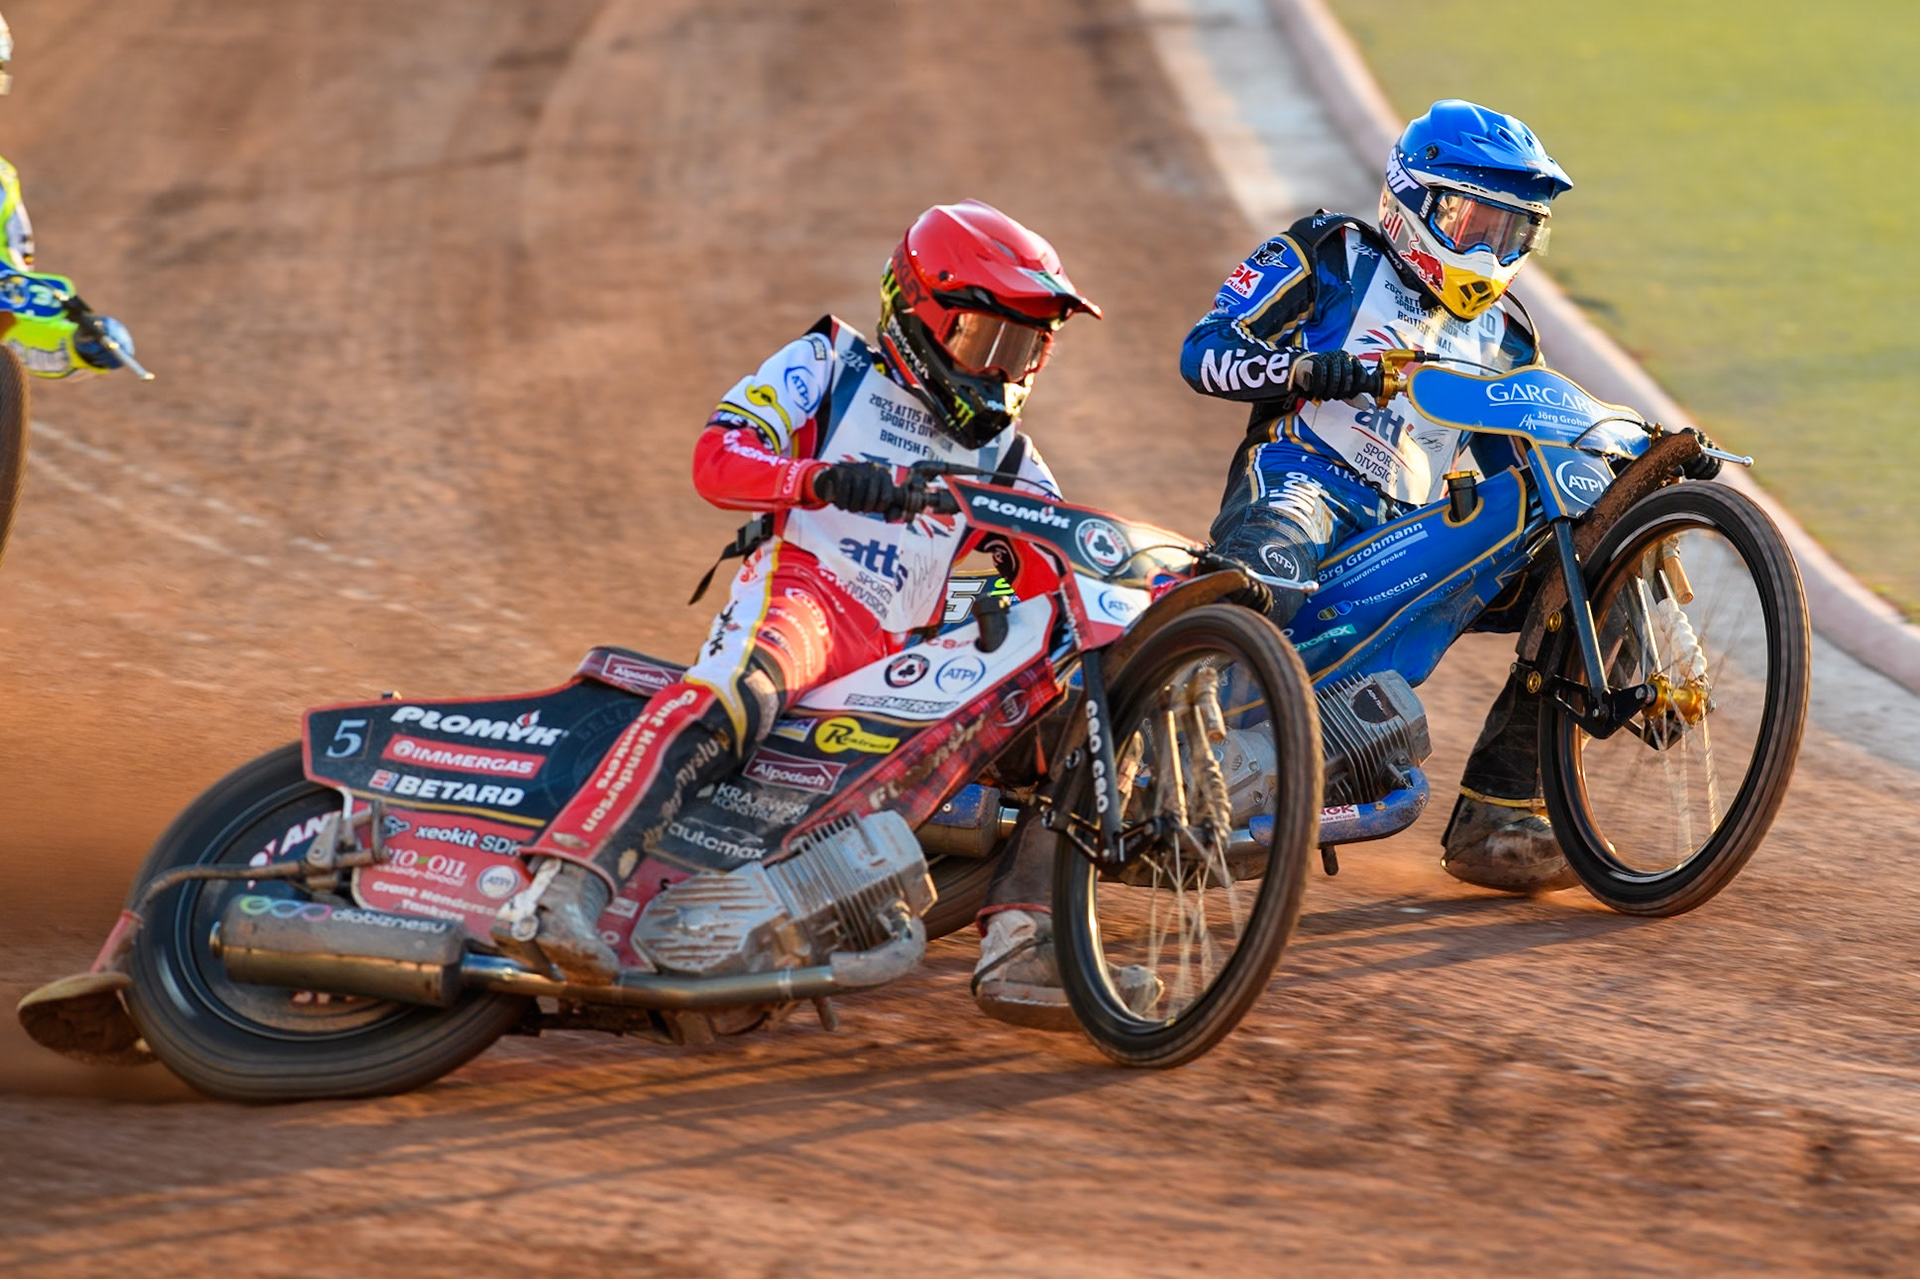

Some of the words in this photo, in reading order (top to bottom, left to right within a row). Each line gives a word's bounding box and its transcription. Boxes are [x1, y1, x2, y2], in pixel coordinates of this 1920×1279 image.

[1382, 212, 1404, 243] ull
[1230, 262, 1258, 289] GK
[868, 393, 894, 412] 2025
[894, 404, 922, 423] ATTIS
[880, 410, 916, 433] SPORTS
[1537, 410, 1559, 423] Jörg
[879, 429, 921, 457] BRITISH
[1362, 441, 1401, 475] SPORTS
[1569, 474, 1604, 493] ATPI
[1268, 551, 1295, 575] ATPI
[1316, 563, 1344, 584] örg
[1346, 522, 1424, 567] Grohmann
[1342, 563, 1381, 588] Insurance
[1380, 549, 1408, 567] Broker
[1354, 571, 1429, 606] Teletecnica
[1292, 625, 1352, 652] OTOREX
[613, 665, 669, 686] Alpodach
[942, 667, 978, 683] ATPI
[649, 689, 699, 728] Grant
[325, 718, 369, 760] 5
[412, 747, 535, 775] IMMERGAS
[752, 763, 826, 787] Alpodach
[394, 774, 525, 807] BETARD
[581, 729, 657, 833] Henderson
[414, 826, 478, 848] xeokit
[372, 881, 418, 898] Grant
[418, 889, 500, 917] Henderso
[400, 900, 466, 922] Tankers
